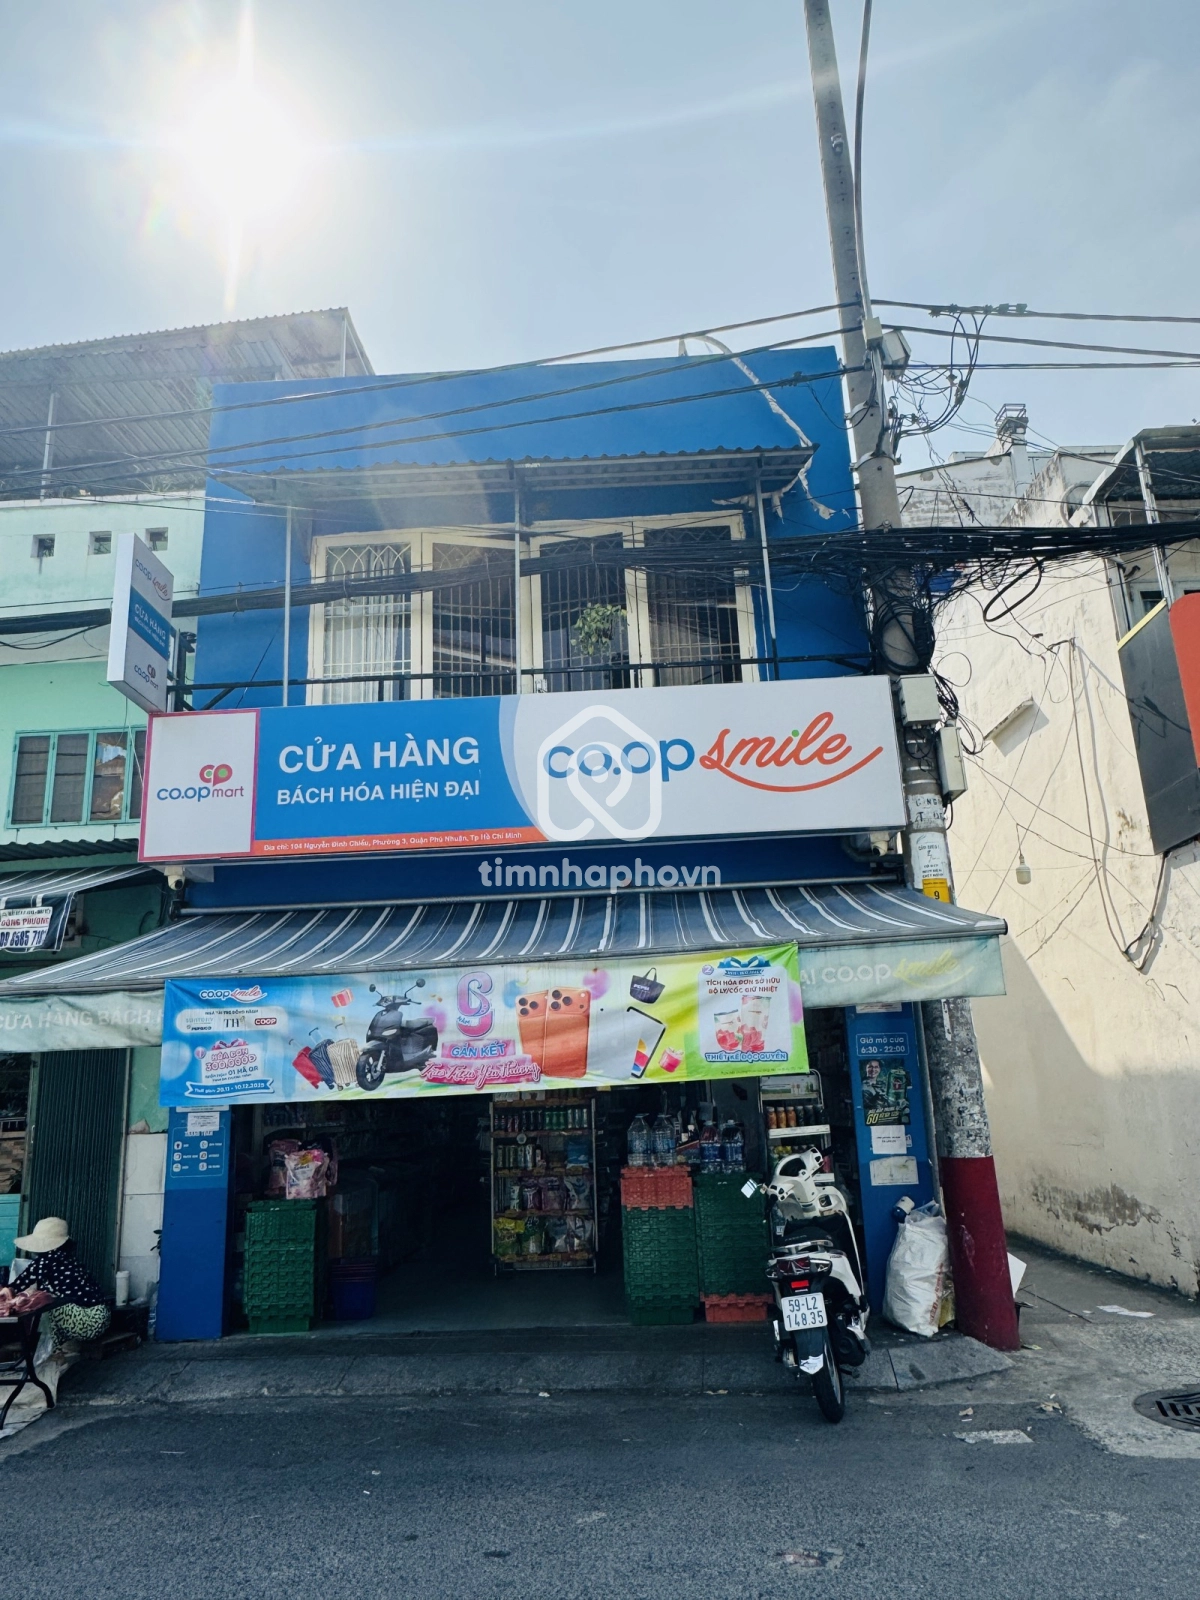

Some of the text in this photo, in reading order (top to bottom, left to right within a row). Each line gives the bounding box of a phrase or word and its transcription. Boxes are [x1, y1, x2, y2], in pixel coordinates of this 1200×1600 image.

[279, 733, 479, 773] CỬA HÀNG
[276, 779, 480, 805] BÁCH HÓA HIỆN ĐẠI
[304, 840, 330, 850] Nguyễn
[372, 839, 401, 847] Phường
[409, 836, 428, 845] Quận
[933, 890, 940, 900] 9
[706, 978, 722, 986] TÍCH
[723, 978, 737, 986] HÓA
[708, 987, 719, 995] BỘ
[38, 1008, 93, 1028] HÀNG
[97, 1008, 152, 1026] BÁCH
[860, 1035, 905, 1044] Giờ mở cửa
[480, 1039, 505, 1056] KẾT
[861, 1046, 878, 1054] 6:30
[883, 1045, 906, 1053] 22:00
[706, 1049, 787, 1062] THIẾT KẾ ĐỘC QUYỀN
[788, 1296, 819, 1313] 59-L2
[786, 1310, 824, 1328] 148.35
